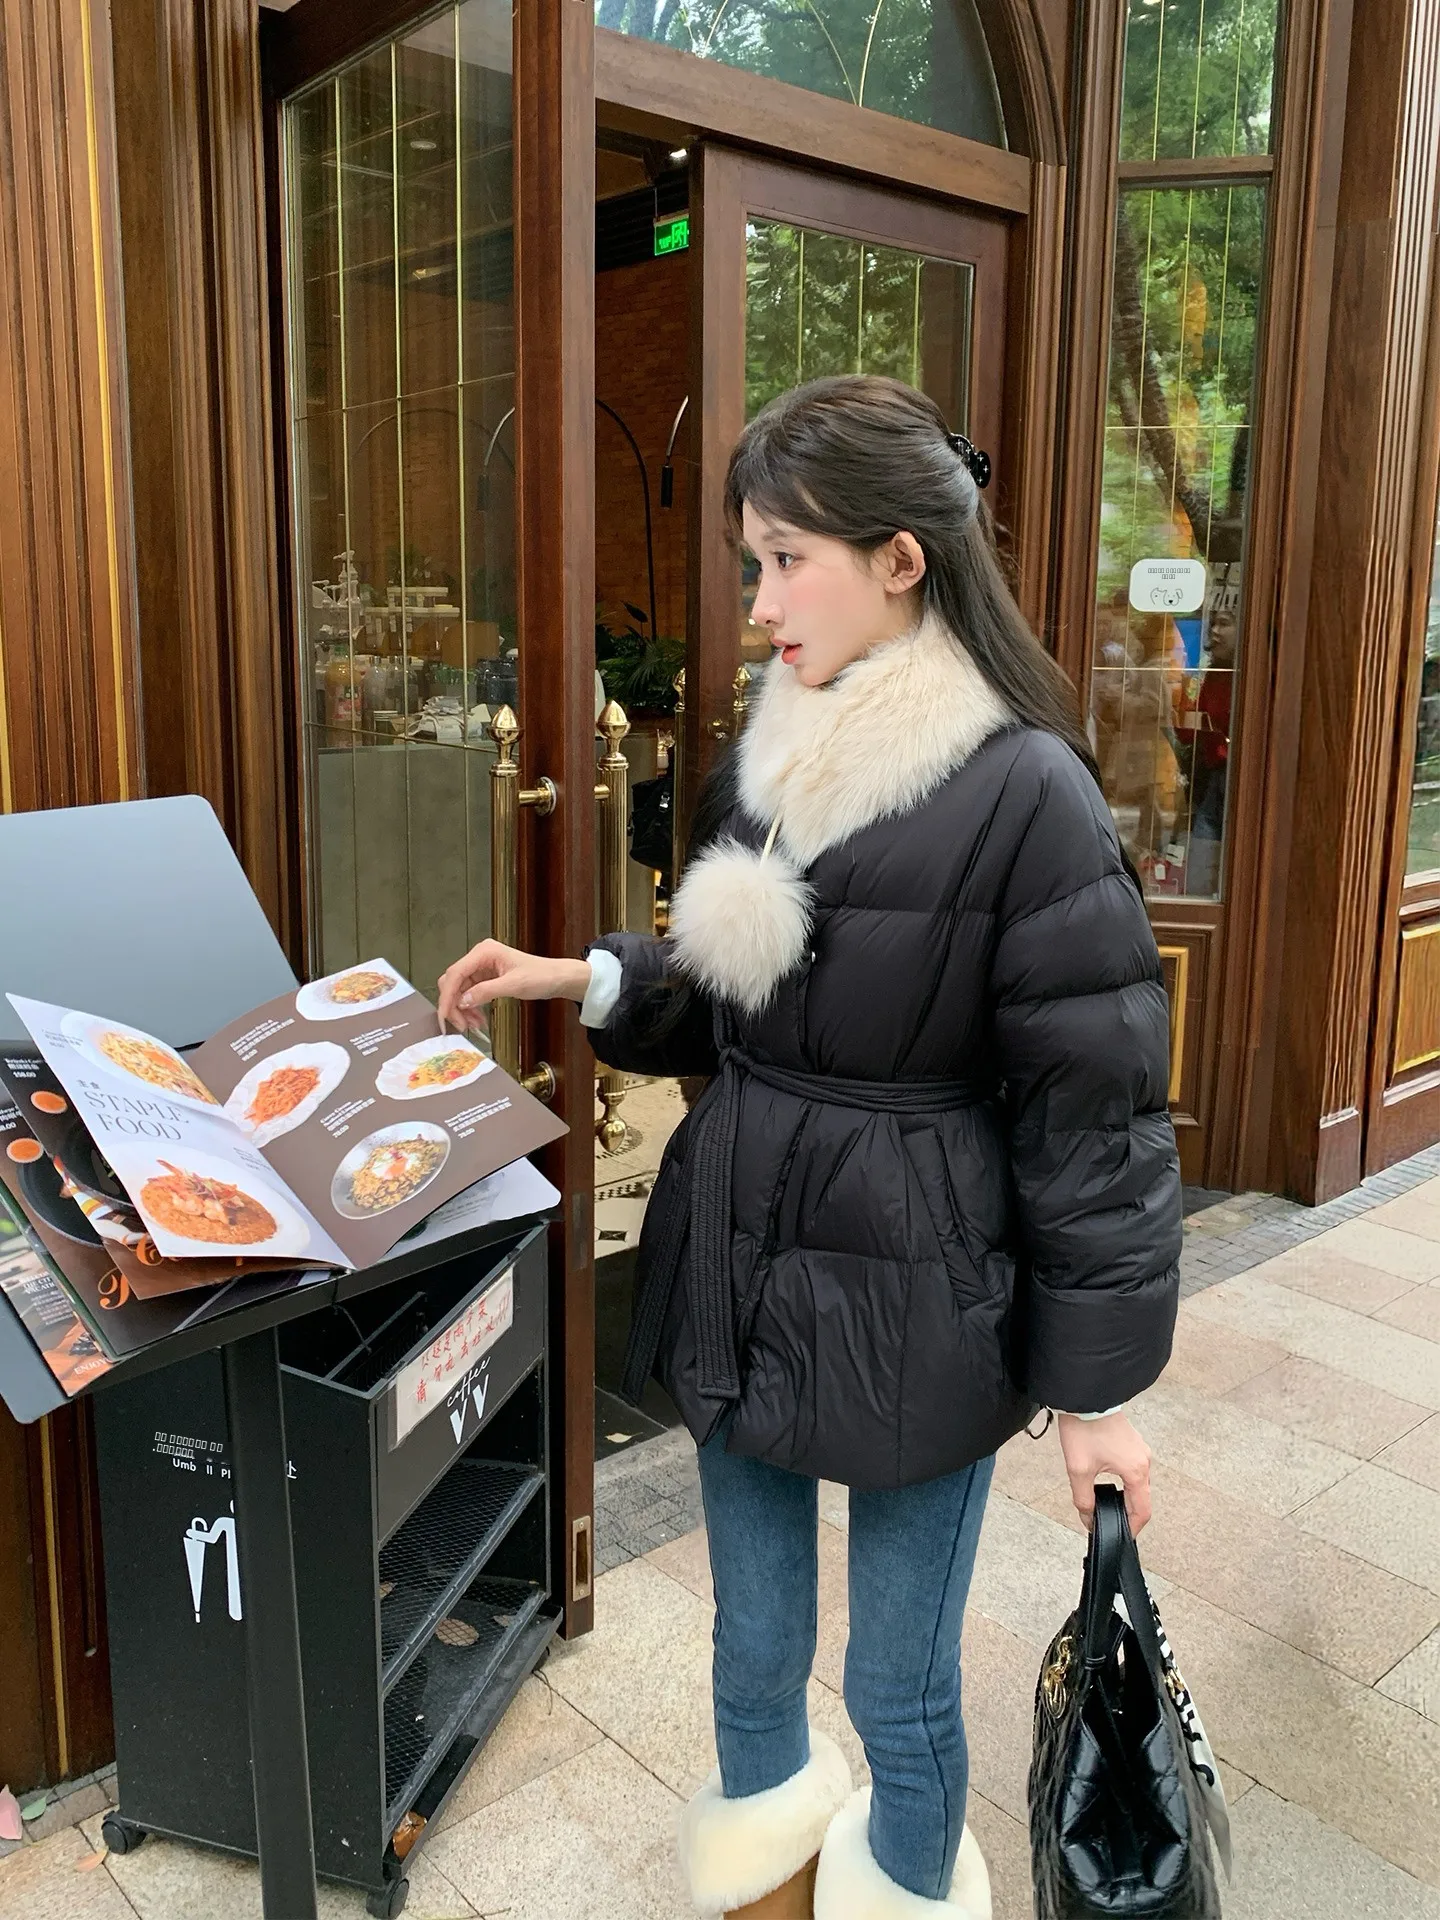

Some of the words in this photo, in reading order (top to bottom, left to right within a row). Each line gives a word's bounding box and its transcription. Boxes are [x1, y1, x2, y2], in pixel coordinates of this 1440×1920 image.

[84, 1091, 189, 1124] STAPLE
[96, 1113, 182, 1141] FOOD
[447, 1356, 491, 1407] coffee
